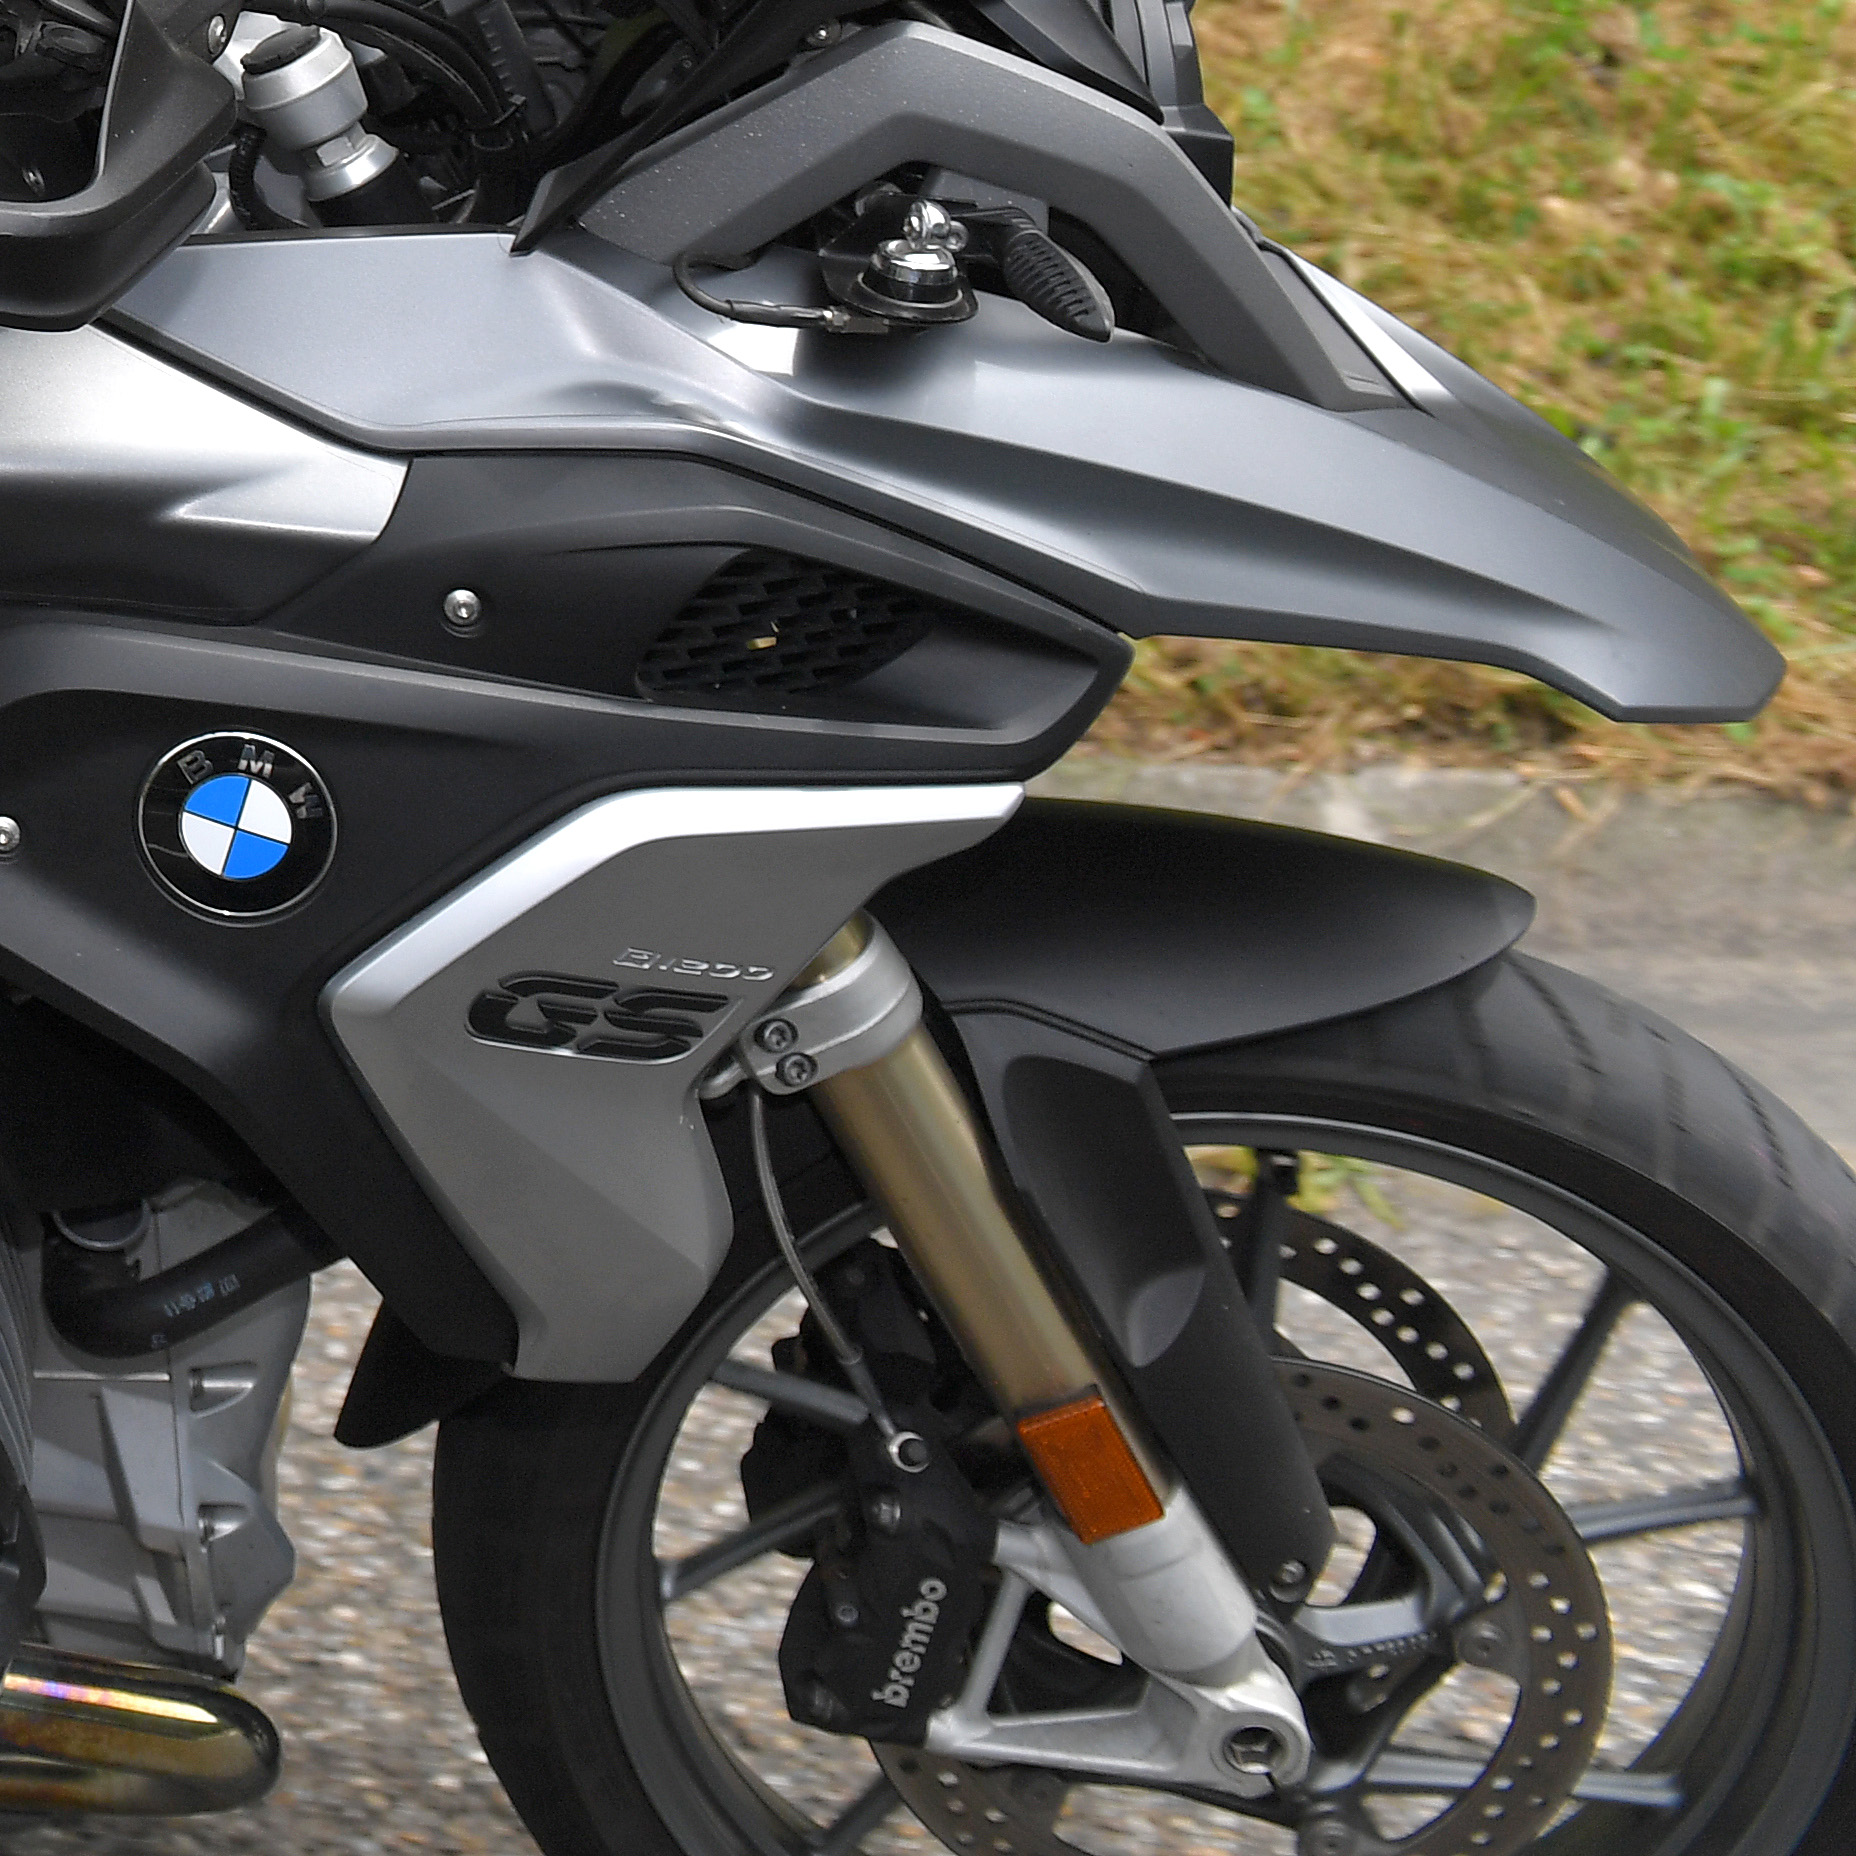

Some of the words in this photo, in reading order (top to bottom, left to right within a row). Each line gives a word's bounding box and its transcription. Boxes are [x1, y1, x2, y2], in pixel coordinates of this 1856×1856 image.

[177, 743, 323, 820] BMW
[464, 971, 730, 1060] GS
[871, 1577, 948, 1708] brembo
